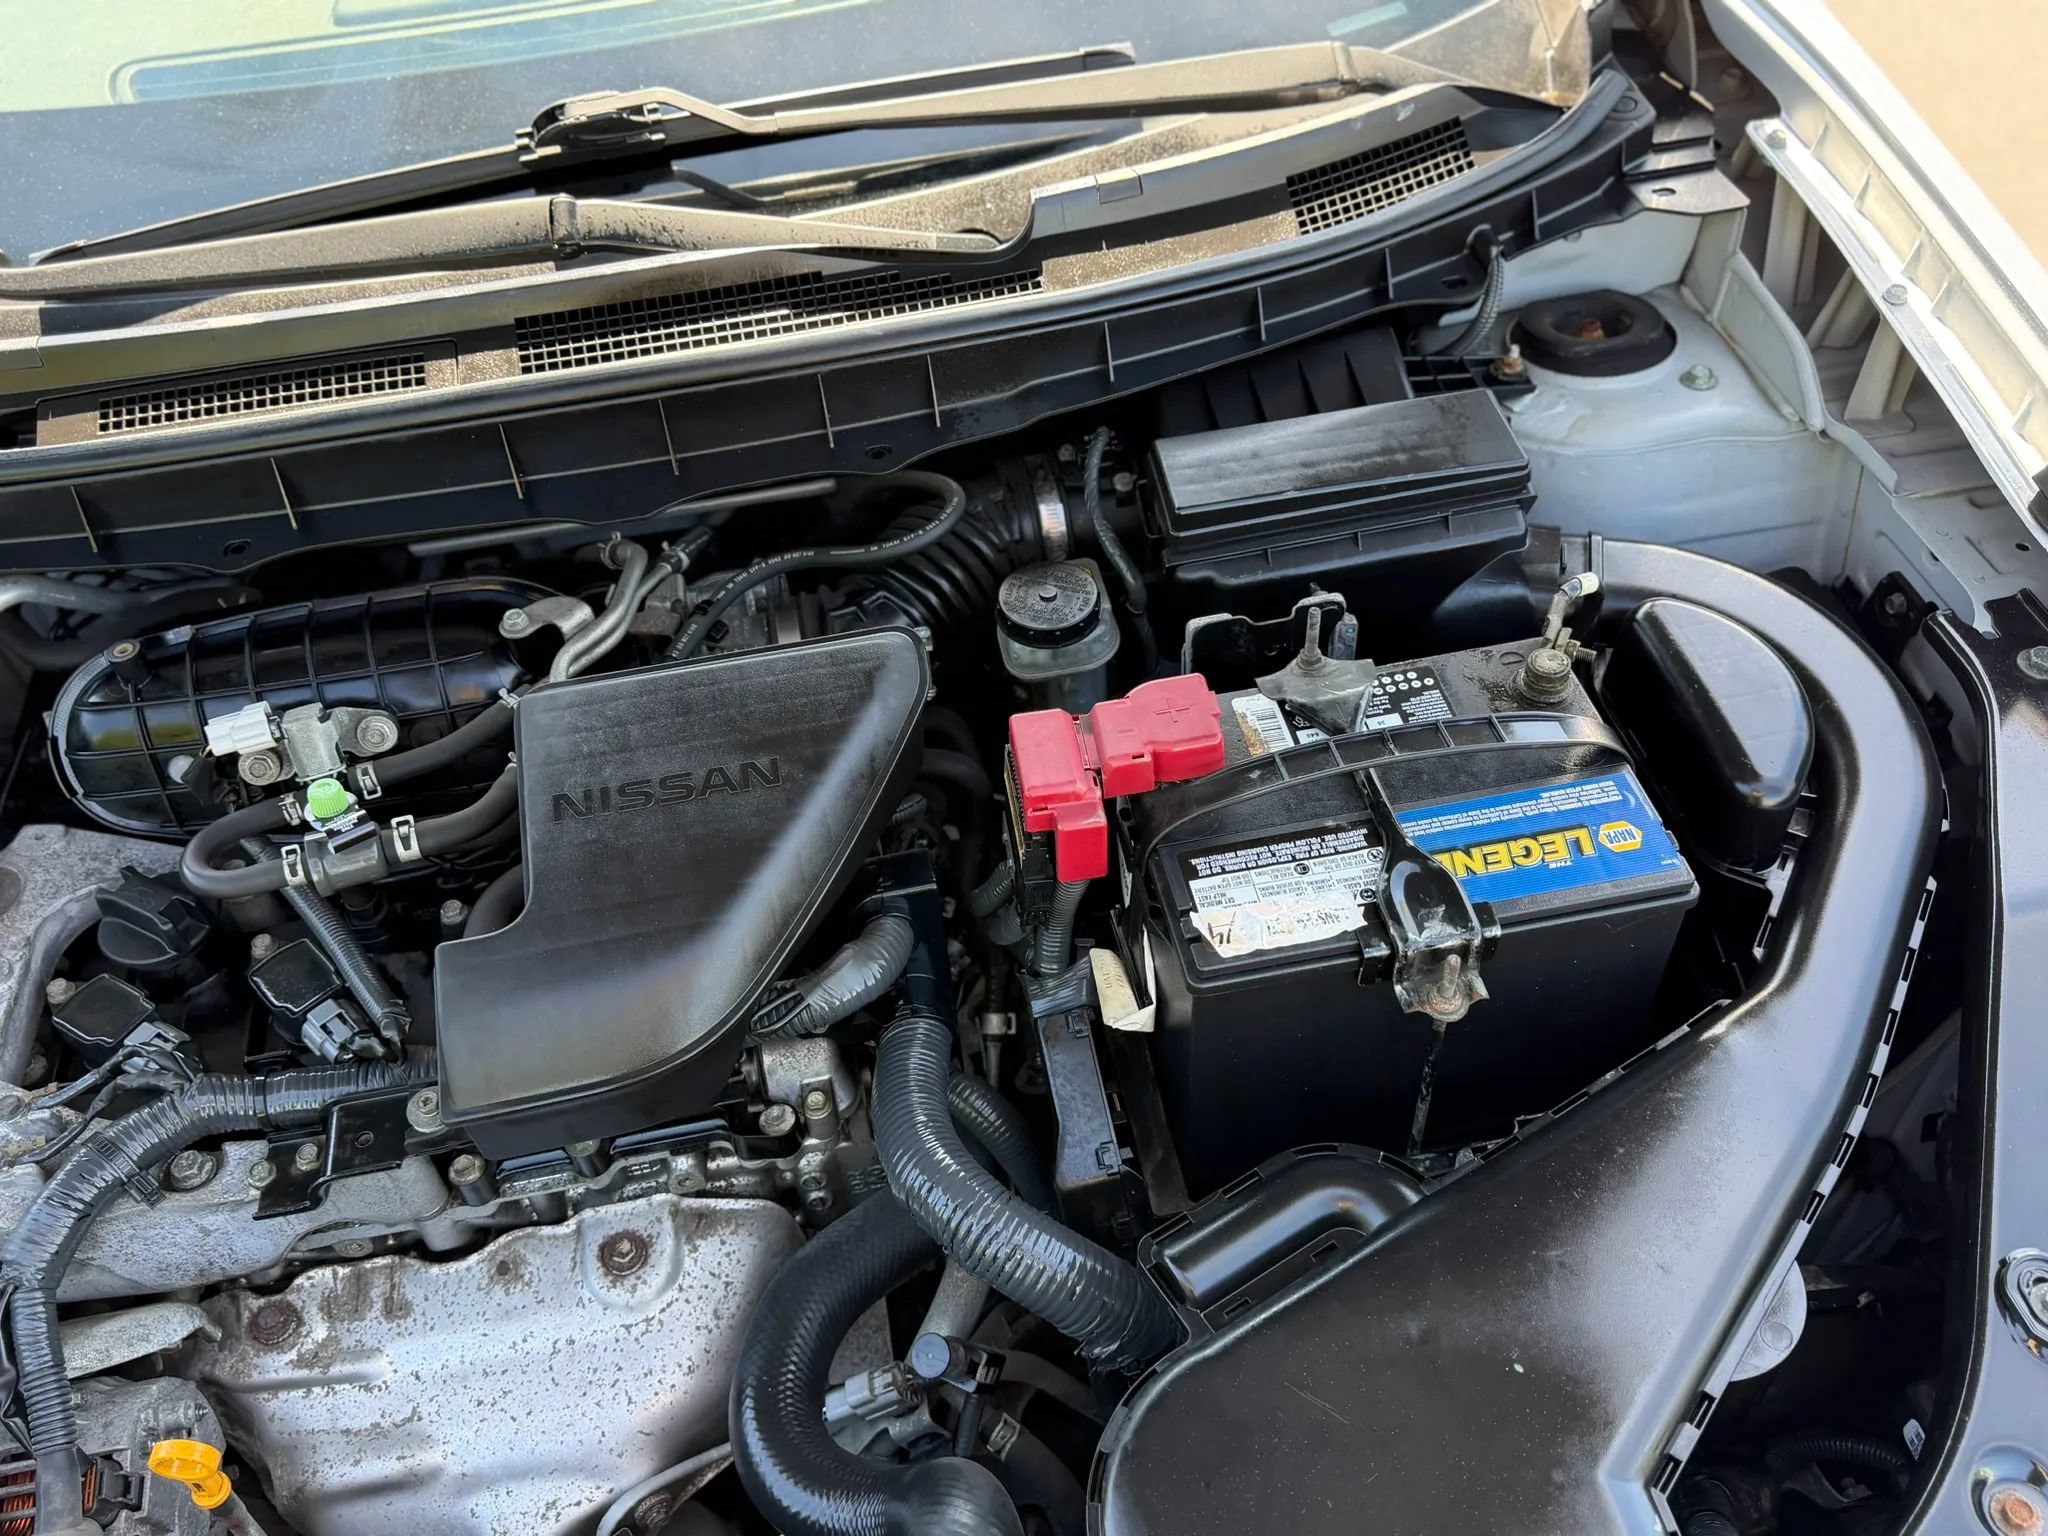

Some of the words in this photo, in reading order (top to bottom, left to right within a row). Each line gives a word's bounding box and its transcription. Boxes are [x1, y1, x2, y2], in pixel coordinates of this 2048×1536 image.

[551, 756, 783, 824] NISSAN
[1320, 833, 1336, 841] USE.
[1336, 827, 1368, 838] INVERTED
[1604, 827, 1636, 846] NAPA
[1268, 840, 1295, 851] PROPER
[1295, 836, 1320, 846] FOLLOW
[1320, 834, 1364, 847] DISASSEMBLE
[1236, 845, 1268, 856] CHARGING
[1310, 842, 1320, 850] OR
[1319, 846, 1334, 855] RISK
[1334, 840, 1368, 852] WARNING:
[1209, 853, 1258, 867] RECOMMENDED
[1256, 854, 1292, 866] EXPLOSION
[1257, 851, 1272, 859] NOT
[1195, 862, 1209, 870] FOR
[1246, 860, 1256, 868] OR
[1547, 859, 1572, 869] THE
[1197, 867, 1211, 876] NOT
[1211, 866, 1222, 874] DO
[1197, 898, 1223, 909] MEDICAL
[1224, 896, 1235, 904] GET
